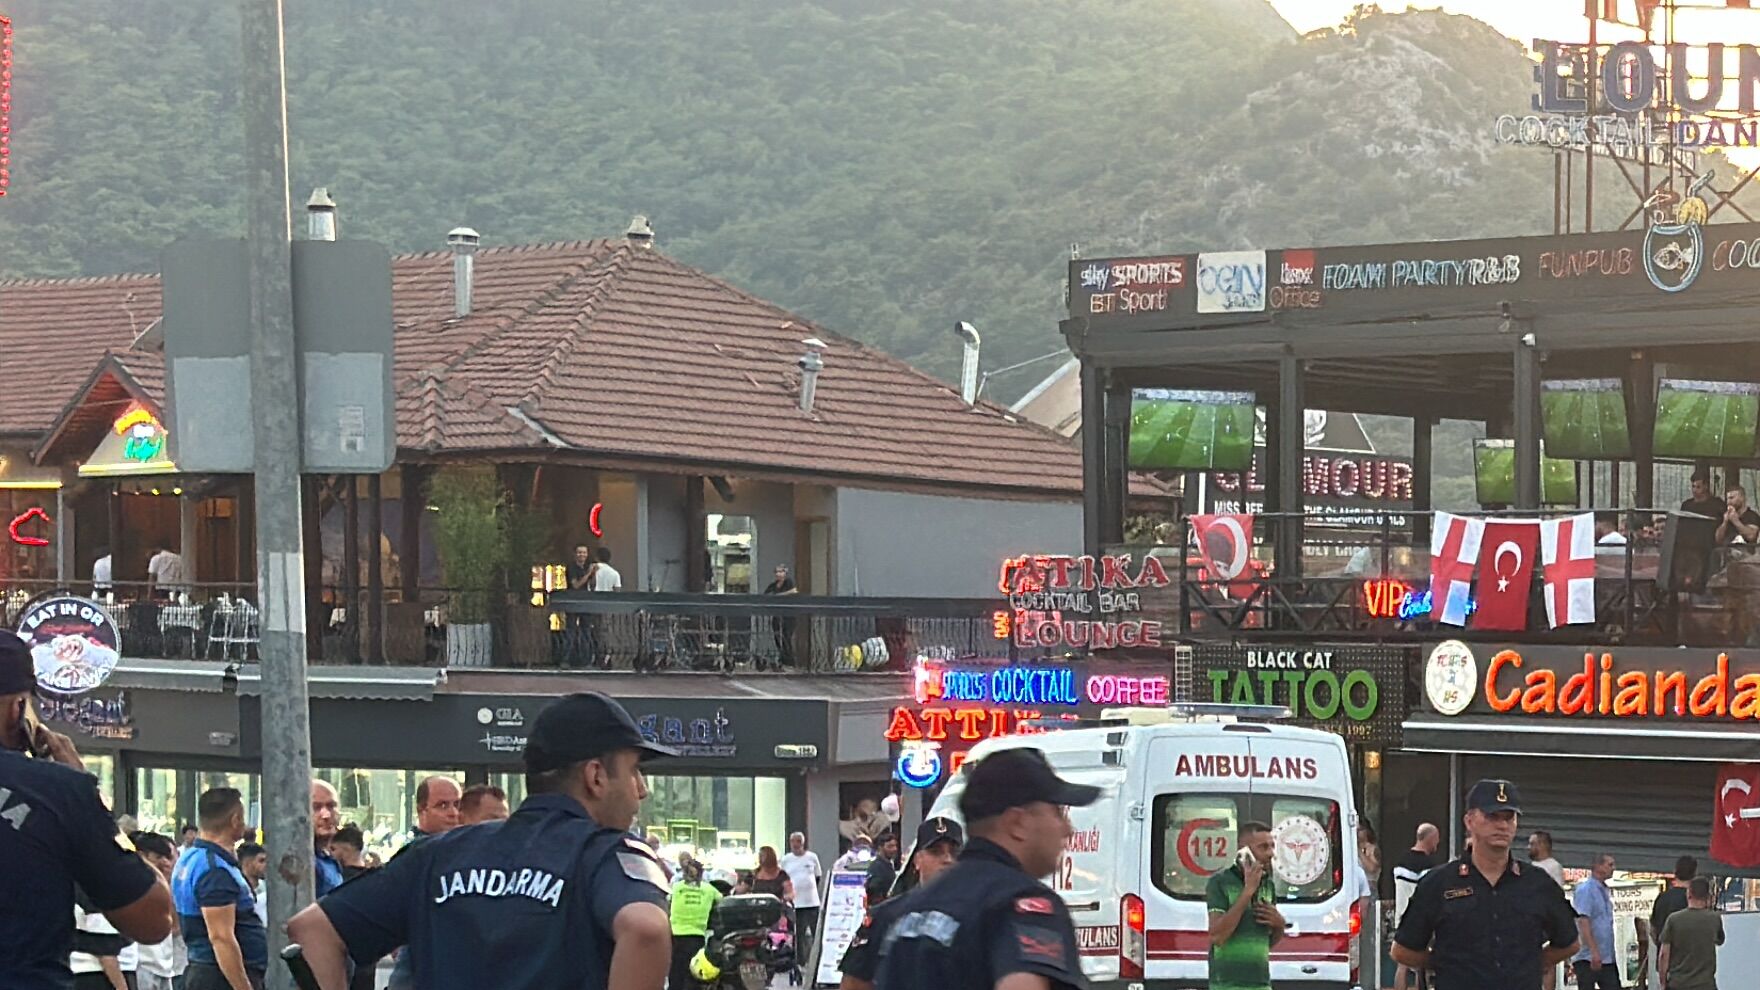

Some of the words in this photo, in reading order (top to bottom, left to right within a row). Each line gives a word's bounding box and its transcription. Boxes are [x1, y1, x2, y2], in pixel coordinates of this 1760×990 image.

[1496, 114, 1661, 147] COCKTAIL
[1323, 256, 1387, 290] FOAM
[1392, 254, 1469, 289] PARTY
[1009, 590, 1092, 613] COCKTAIL
[1099, 590, 1142, 613] BAR
[1363, 578, 1402, 617] VIP
[27, 604, 57, 629] EAT
[60, 603, 78, 615] IN
[80, 606, 105, 627] OR
[1015, 620, 1162, 649] LOUNGE
[1247, 651, 1299, 669] BLACK
[1303, 651, 1333, 669] CAT
[991, 667, 1079, 704] COCKTAIL
[1086, 674, 1170, 704] COFFEE
[1207, 668, 1379, 721] TATTOO
[638, 707, 735, 744] gant
[1175, 753, 1318, 780] AMBULANS
[1190, 835, 1227, 858] 112
[434, 868, 565, 908] JANDARMA
[1076, 927, 1118, 948] ULANS
